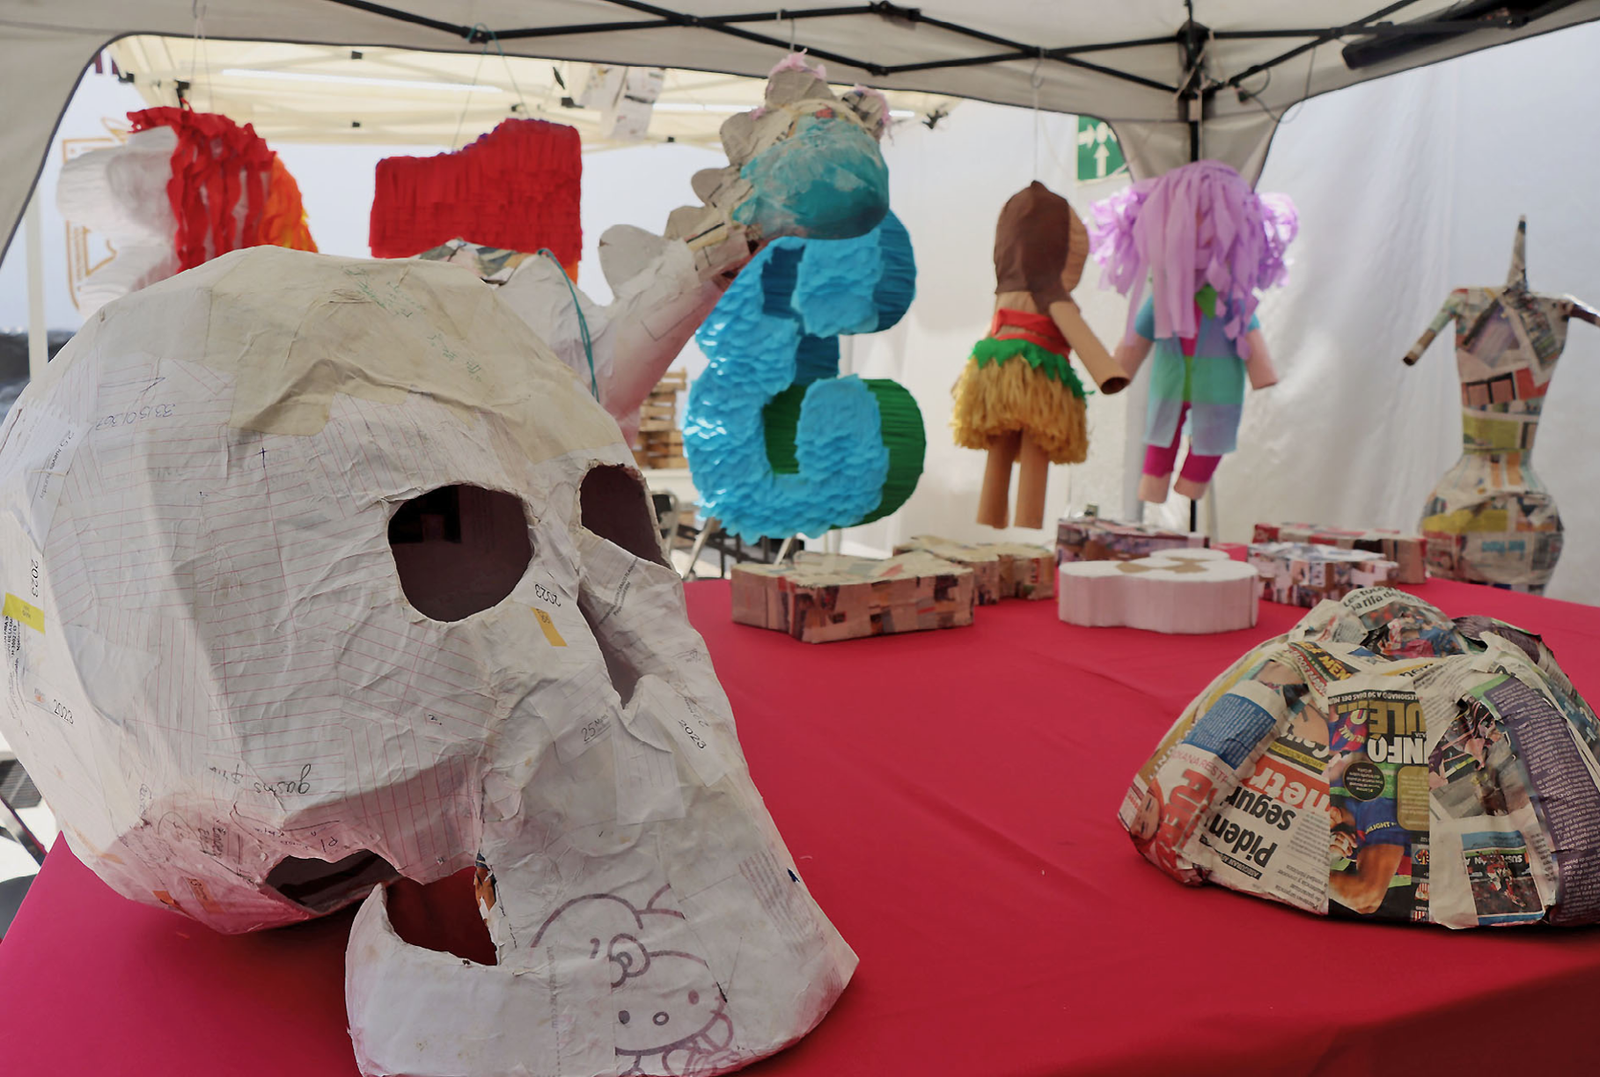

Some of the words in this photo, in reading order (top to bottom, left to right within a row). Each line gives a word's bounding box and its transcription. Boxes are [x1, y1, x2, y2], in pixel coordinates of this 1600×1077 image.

[30, 559, 39, 598] 2023
[535, 583, 561, 607] 2023
[53, 699, 74, 725] 2023
[581, 722, 596, 741] 25
[678, 719, 707, 750] 2023
[1208, 813, 1278, 868] Piden
